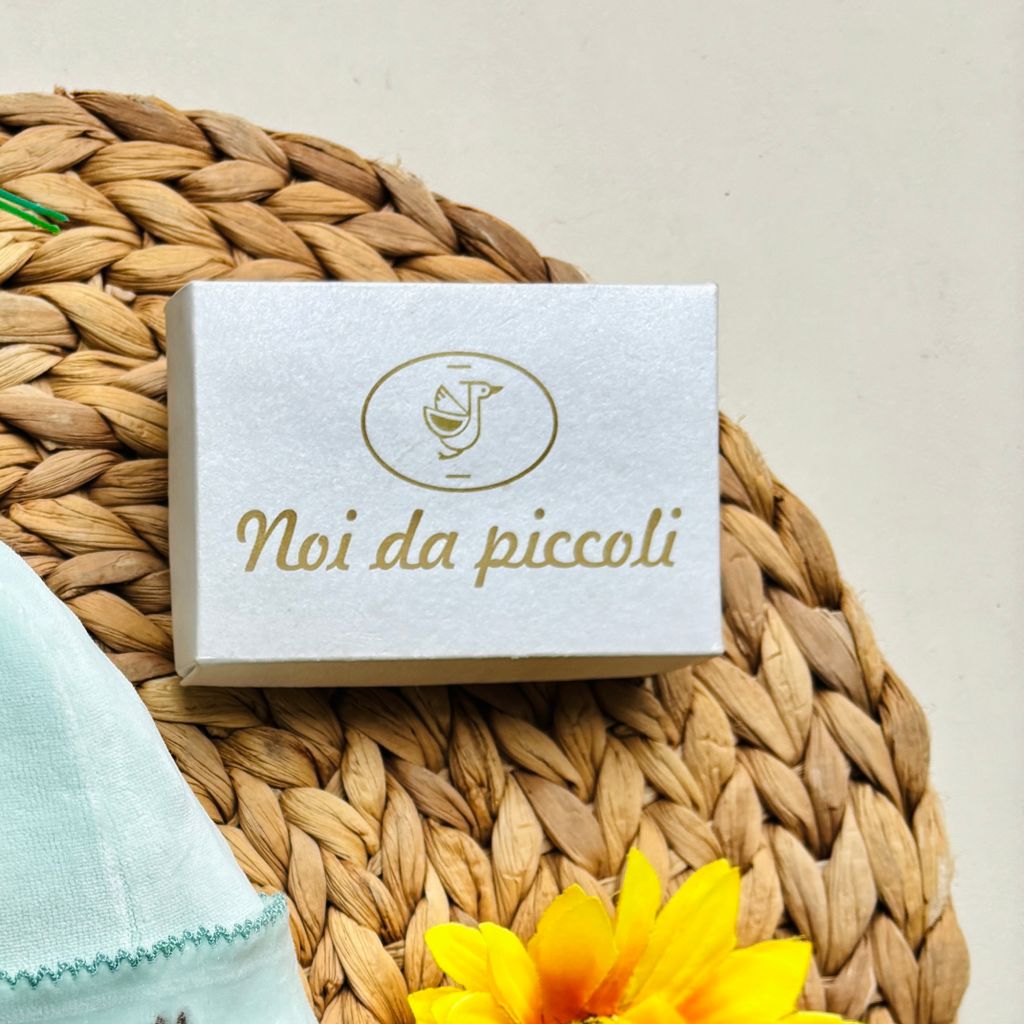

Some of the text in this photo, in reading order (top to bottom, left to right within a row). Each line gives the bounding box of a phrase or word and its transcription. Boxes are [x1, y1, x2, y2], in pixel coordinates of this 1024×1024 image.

[236, 507, 682, 588] Noi da piccoli
